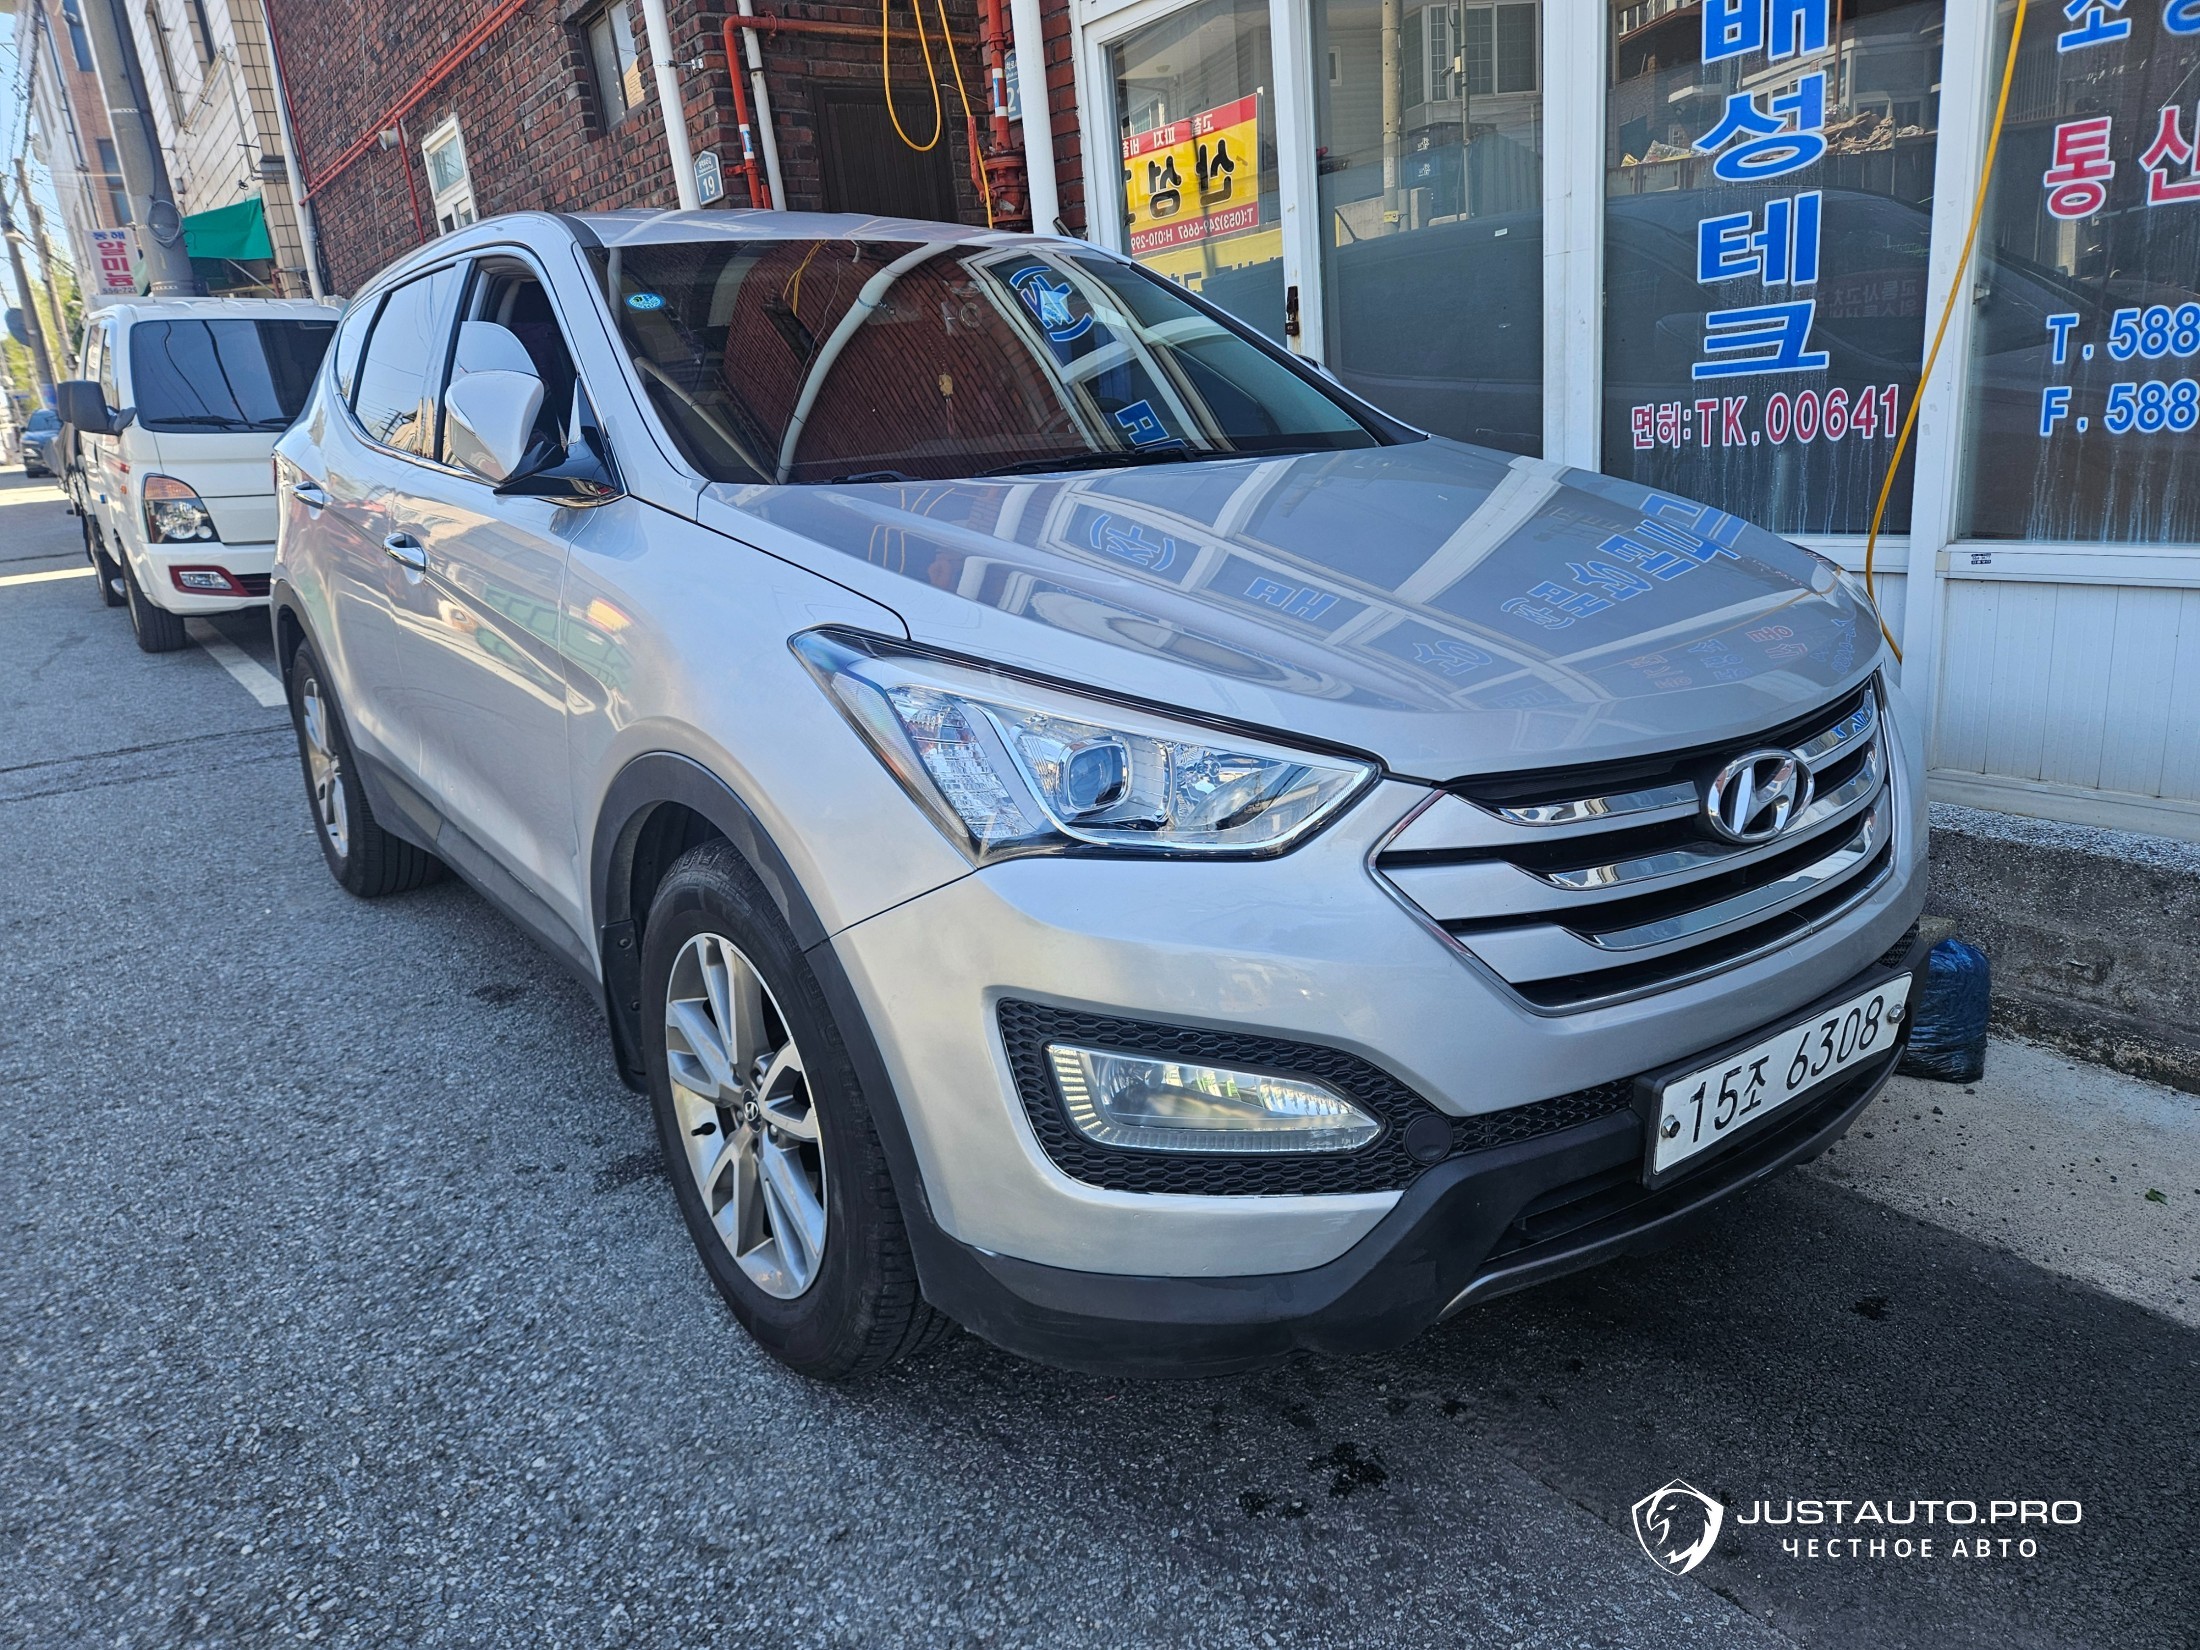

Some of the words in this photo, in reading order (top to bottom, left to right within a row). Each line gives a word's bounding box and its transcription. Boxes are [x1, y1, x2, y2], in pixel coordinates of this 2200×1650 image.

[703, 175, 715, 196] 19
[1690, 1055, 1770, 1143] 15조
[1785, 995, 1884, 1091] 6308
